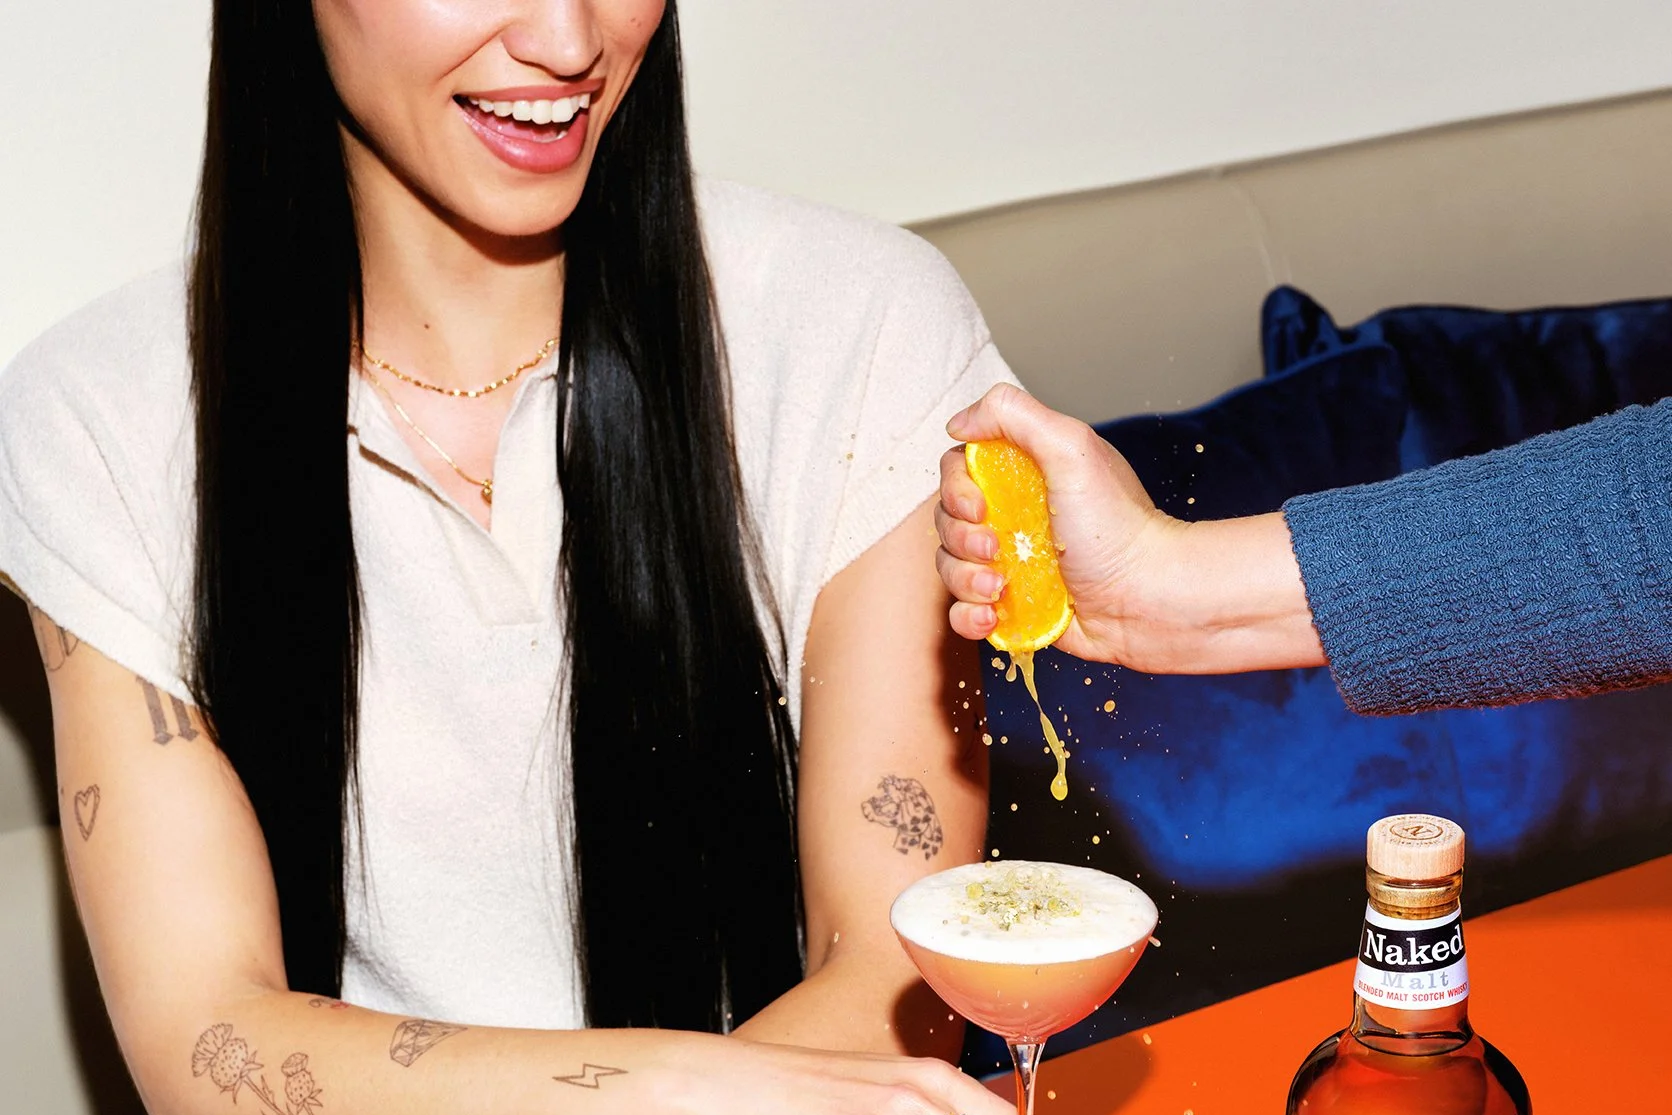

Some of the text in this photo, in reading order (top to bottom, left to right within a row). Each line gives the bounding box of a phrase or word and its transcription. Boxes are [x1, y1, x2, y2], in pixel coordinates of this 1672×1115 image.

[1364, 924, 1464, 966] Naked
[1358, 979, 1469, 1002] BLENDED MALT SCOTCH WHISKY
[1380, 972, 1450, 989] Malt
